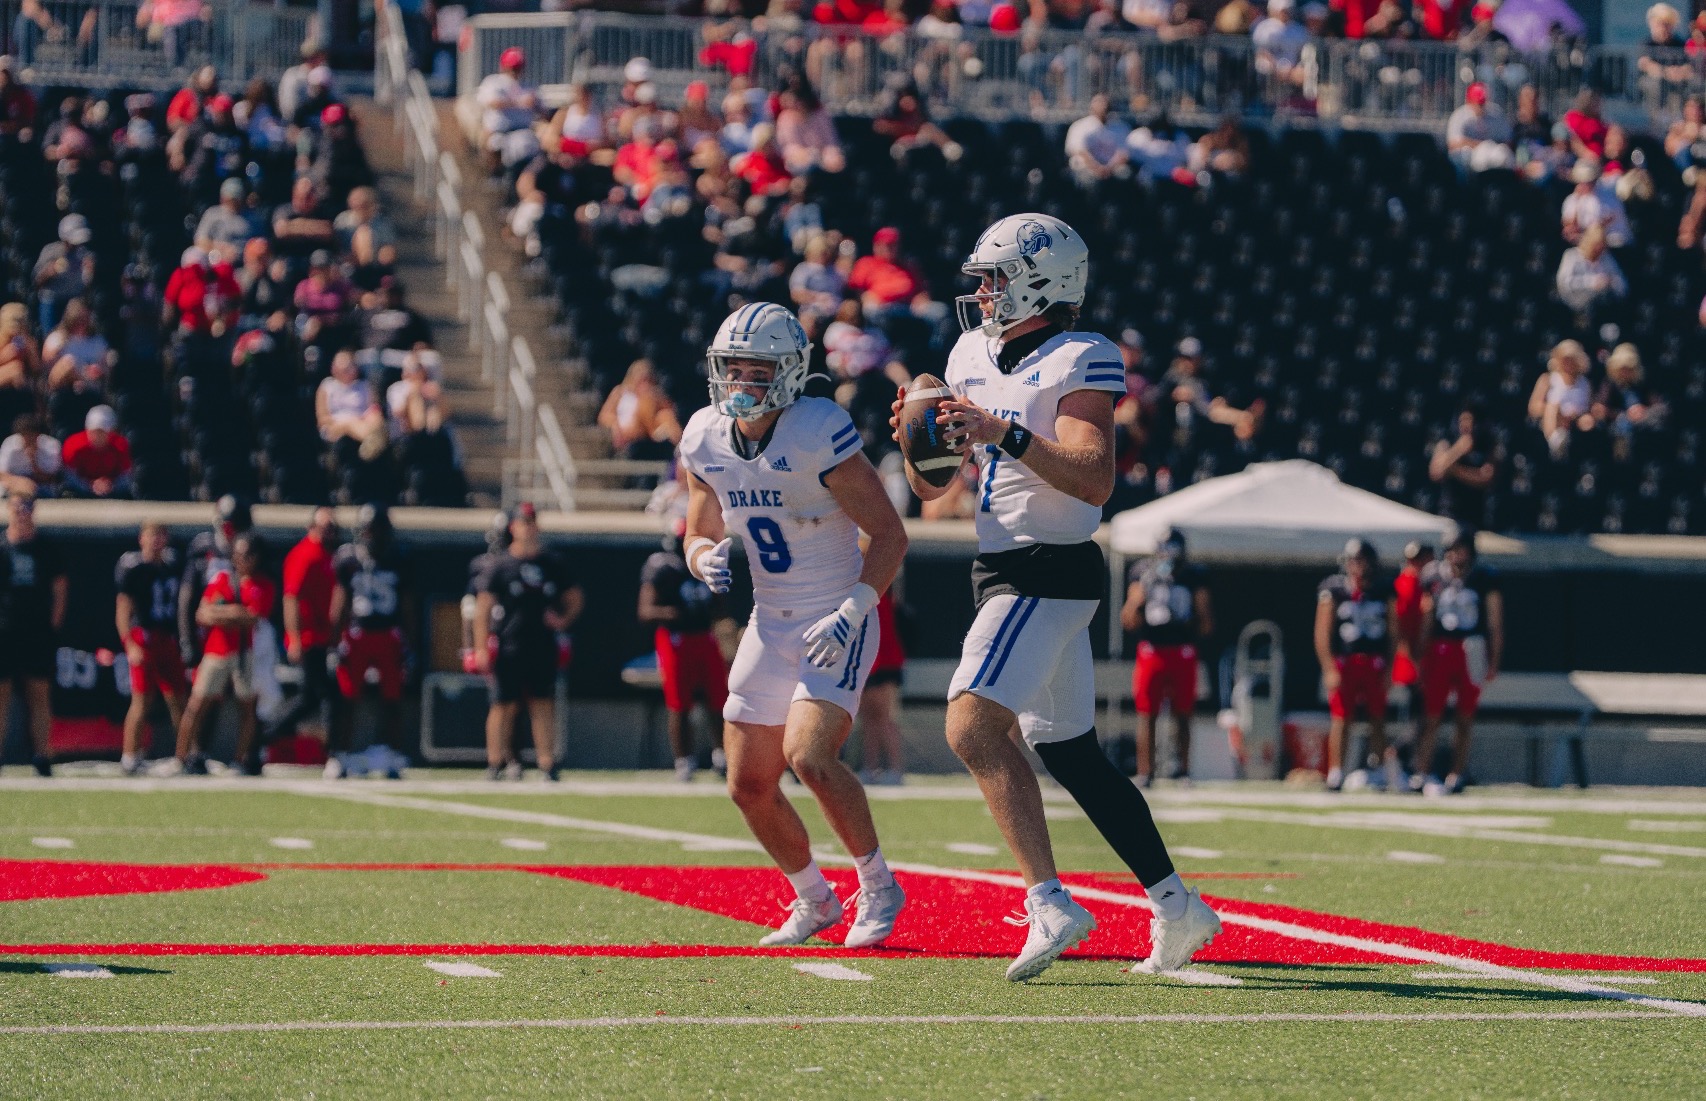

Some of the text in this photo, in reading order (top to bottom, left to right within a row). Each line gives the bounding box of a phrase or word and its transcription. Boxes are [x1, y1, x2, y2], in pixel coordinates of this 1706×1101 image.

[924, 407, 937, 446] Wilson
[727, 488, 783, 508] DRAKE
[746, 516, 792, 574] 9
